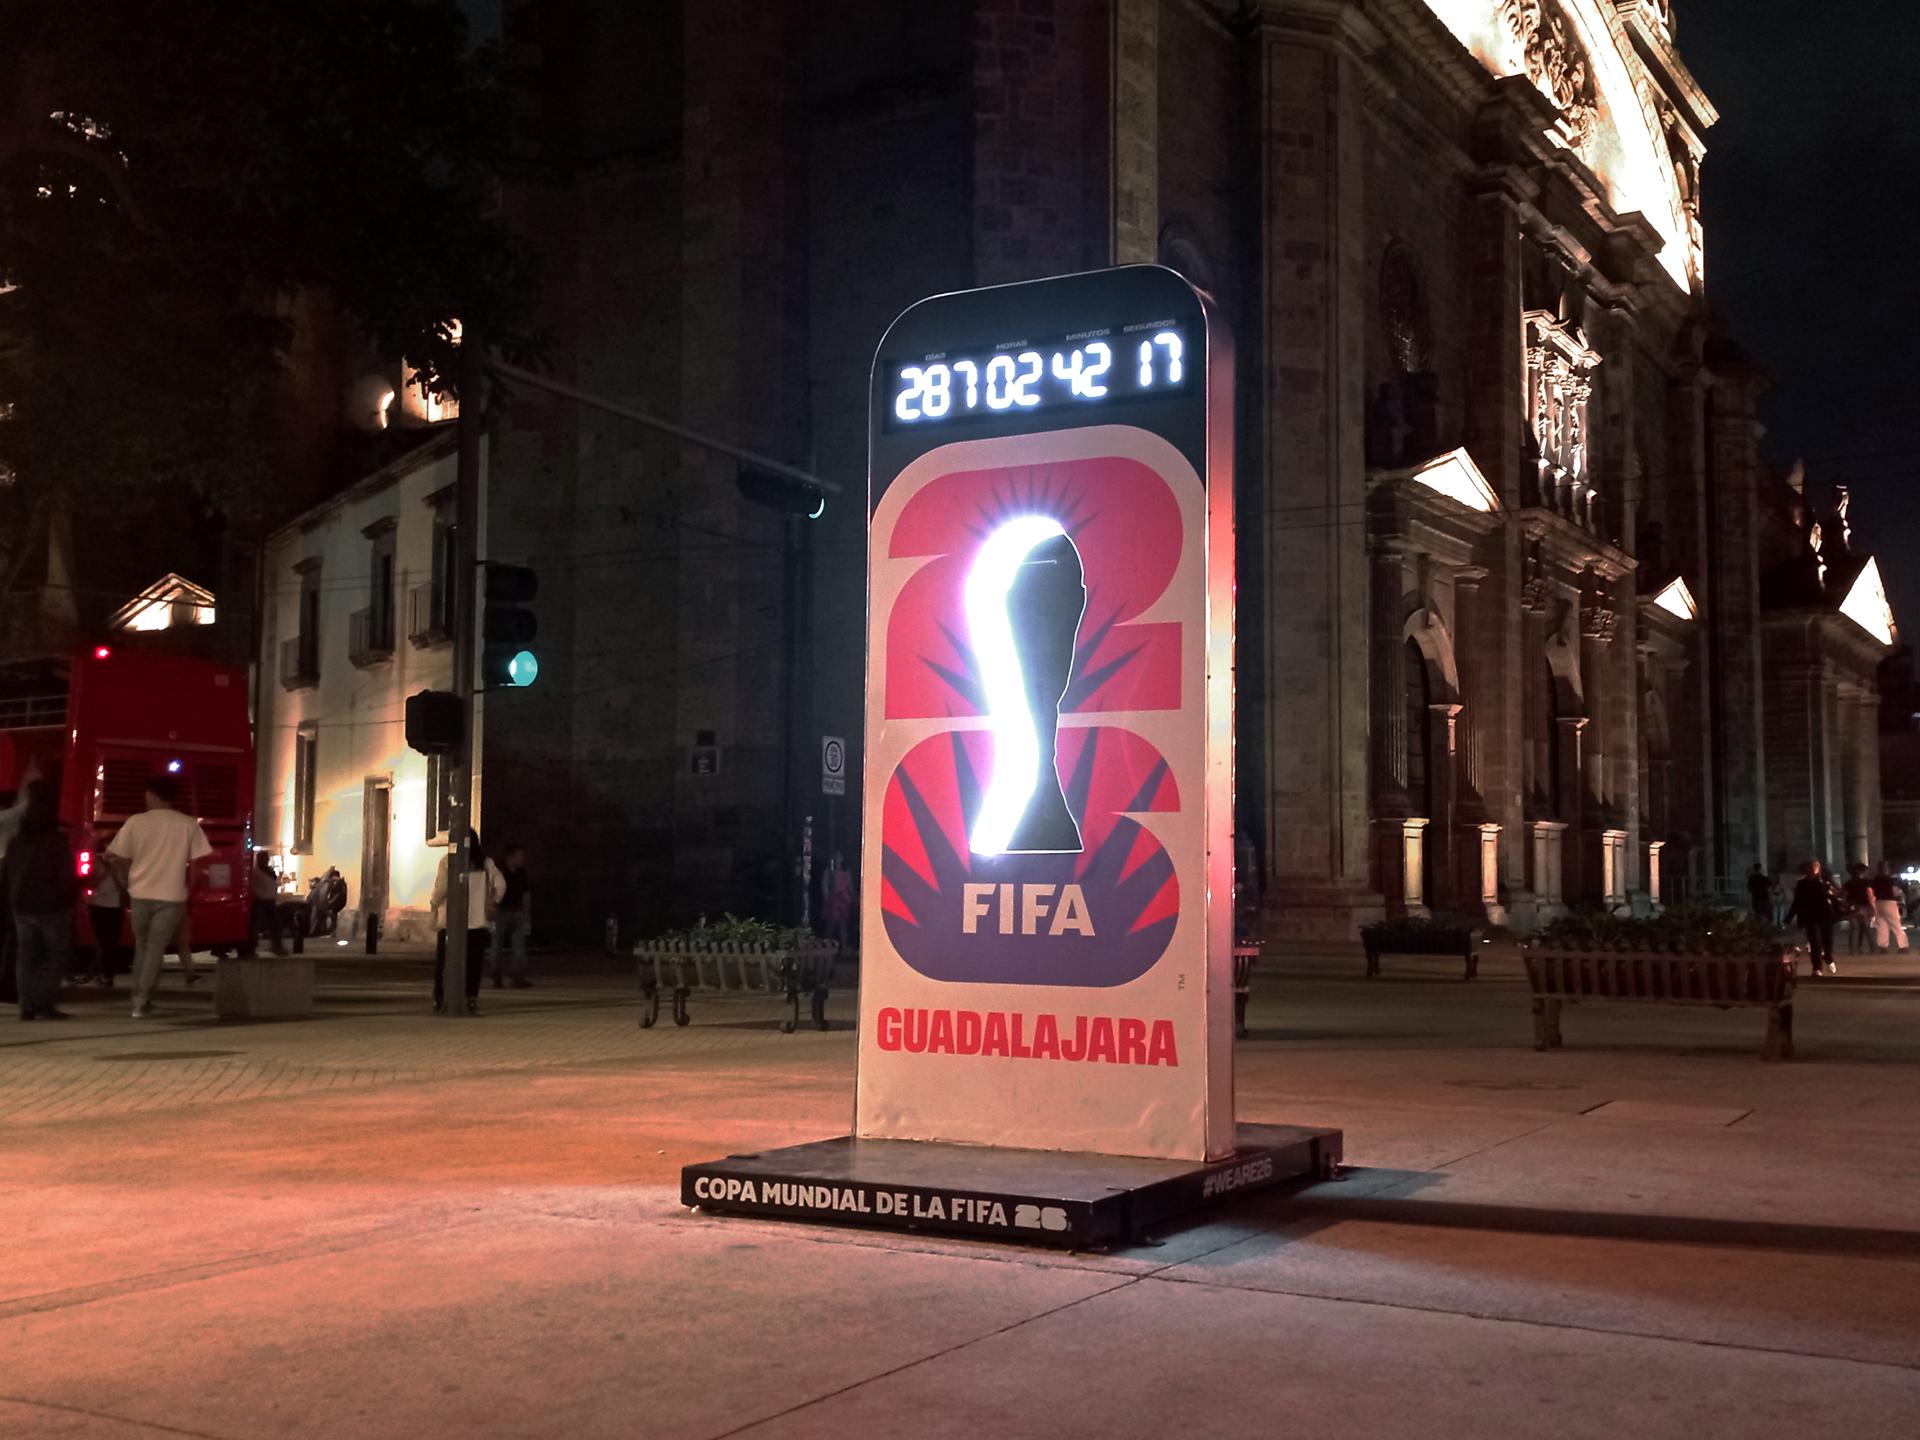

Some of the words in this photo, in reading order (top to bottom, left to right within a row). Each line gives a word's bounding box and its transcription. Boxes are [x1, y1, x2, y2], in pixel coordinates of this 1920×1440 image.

[996, 339, 1028, 349] HORAS
[1066, 328, 1110, 341] MINUTOS
[1123, 319, 1176, 332] SEGUNDOS
[896, 360, 978, 420] 287
[986, 351, 1043, 409] 02
[1052, 342, 1110, 398] 42
[1140, 332, 1182, 386] 17
[963, 883, 1095, 936] FIFA
[877, 1007, 1178, 1067] GUADALAJARA
[694, 1177, 757, 1203] COPA
[762, 1182, 871, 1213] MUNDIAL
[876, 1191, 908, 1216] DE
[913, 1195, 946, 1220] LA
[951, 1198, 1008, 1226] FIFA
[1014, 1204, 1067, 1231] 26
[1203, 1158, 1272, 1199] #WEARE26
